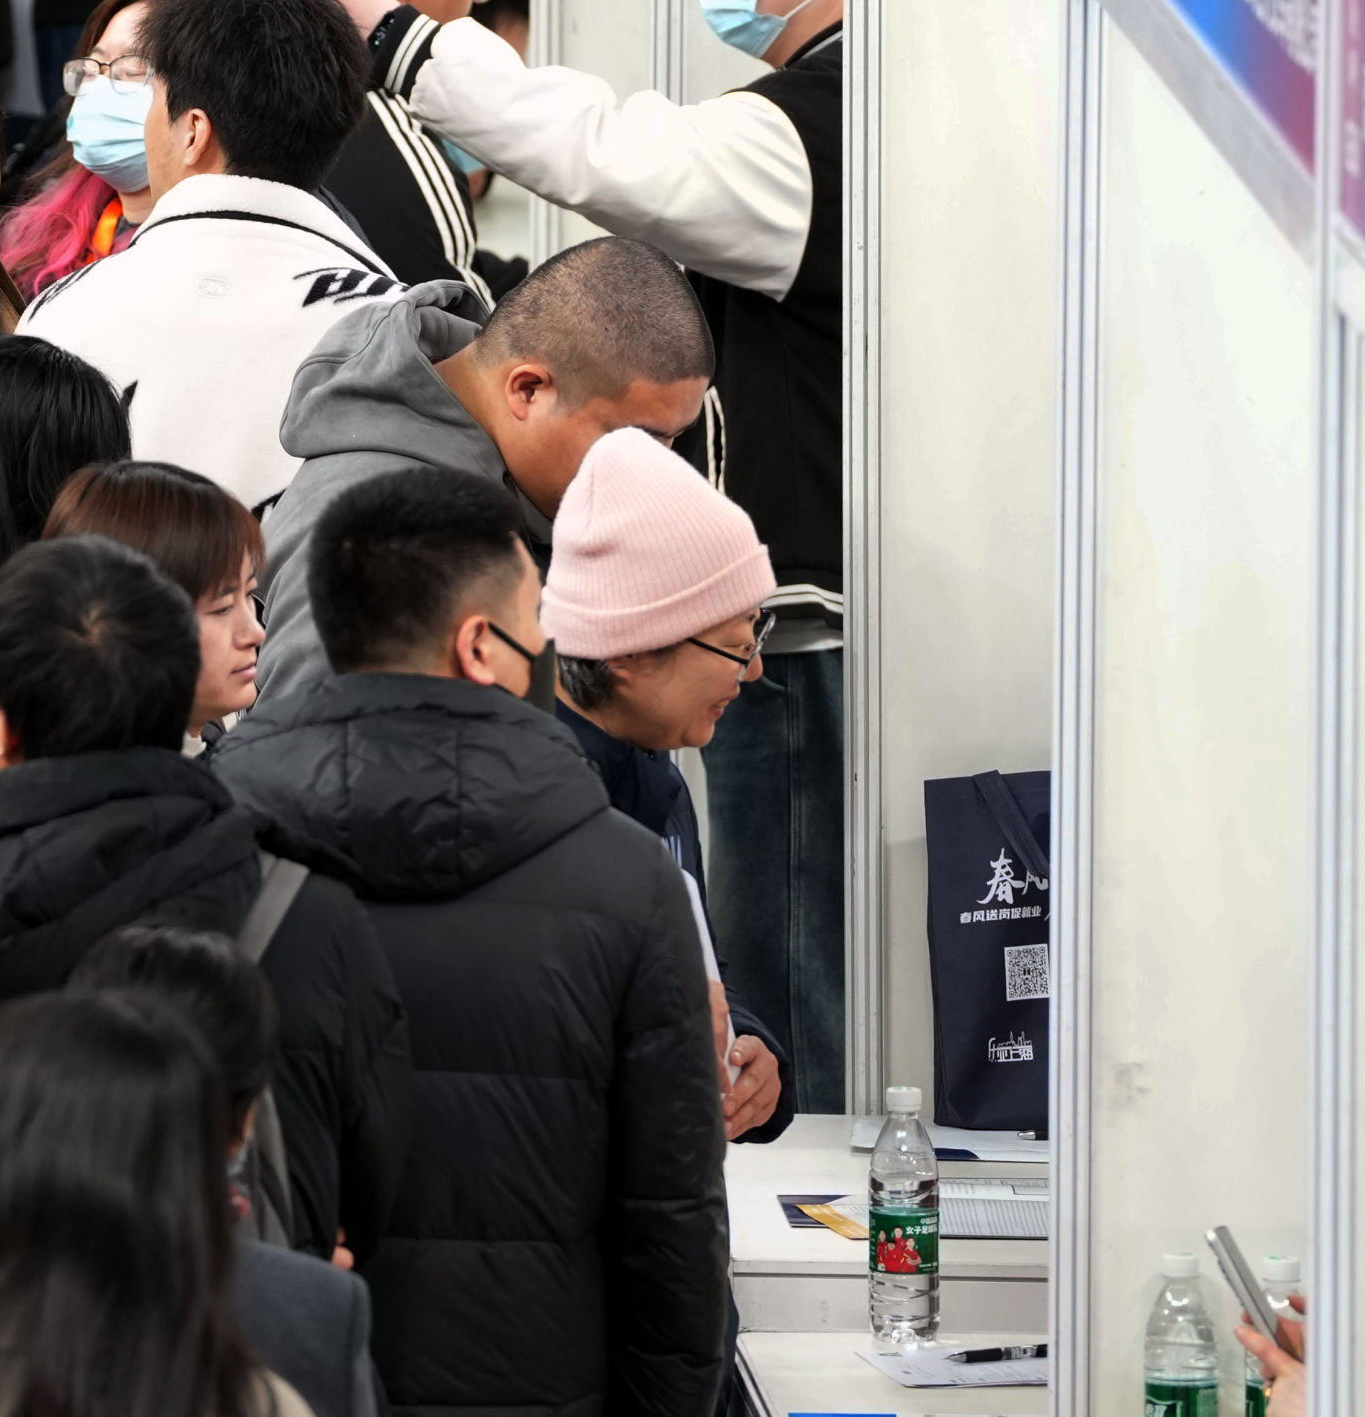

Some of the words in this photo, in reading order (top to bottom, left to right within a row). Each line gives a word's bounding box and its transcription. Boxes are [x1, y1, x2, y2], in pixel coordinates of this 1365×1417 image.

[960, 905, 1042, 924] 春风送岗促就业
